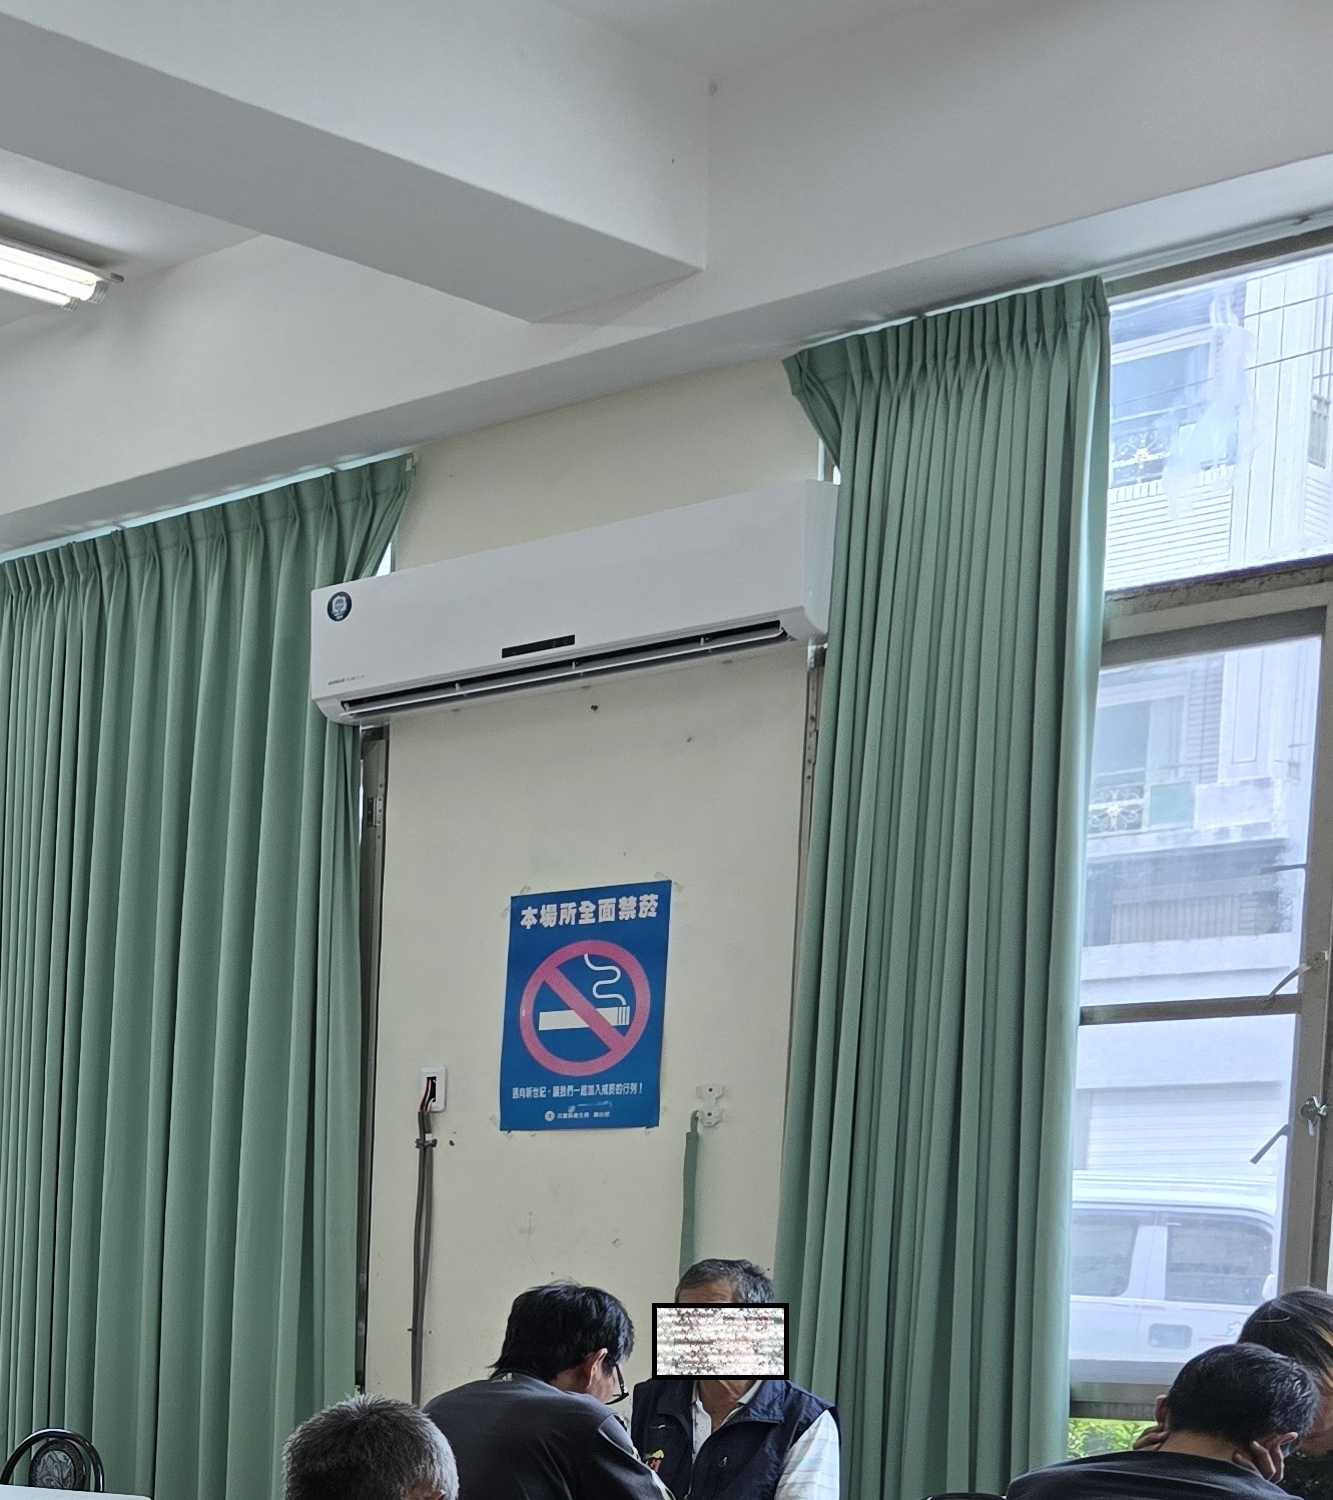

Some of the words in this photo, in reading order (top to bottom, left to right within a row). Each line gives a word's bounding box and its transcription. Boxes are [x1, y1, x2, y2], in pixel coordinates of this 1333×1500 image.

[520, 894, 658, 929] 本場所全面禁菸
